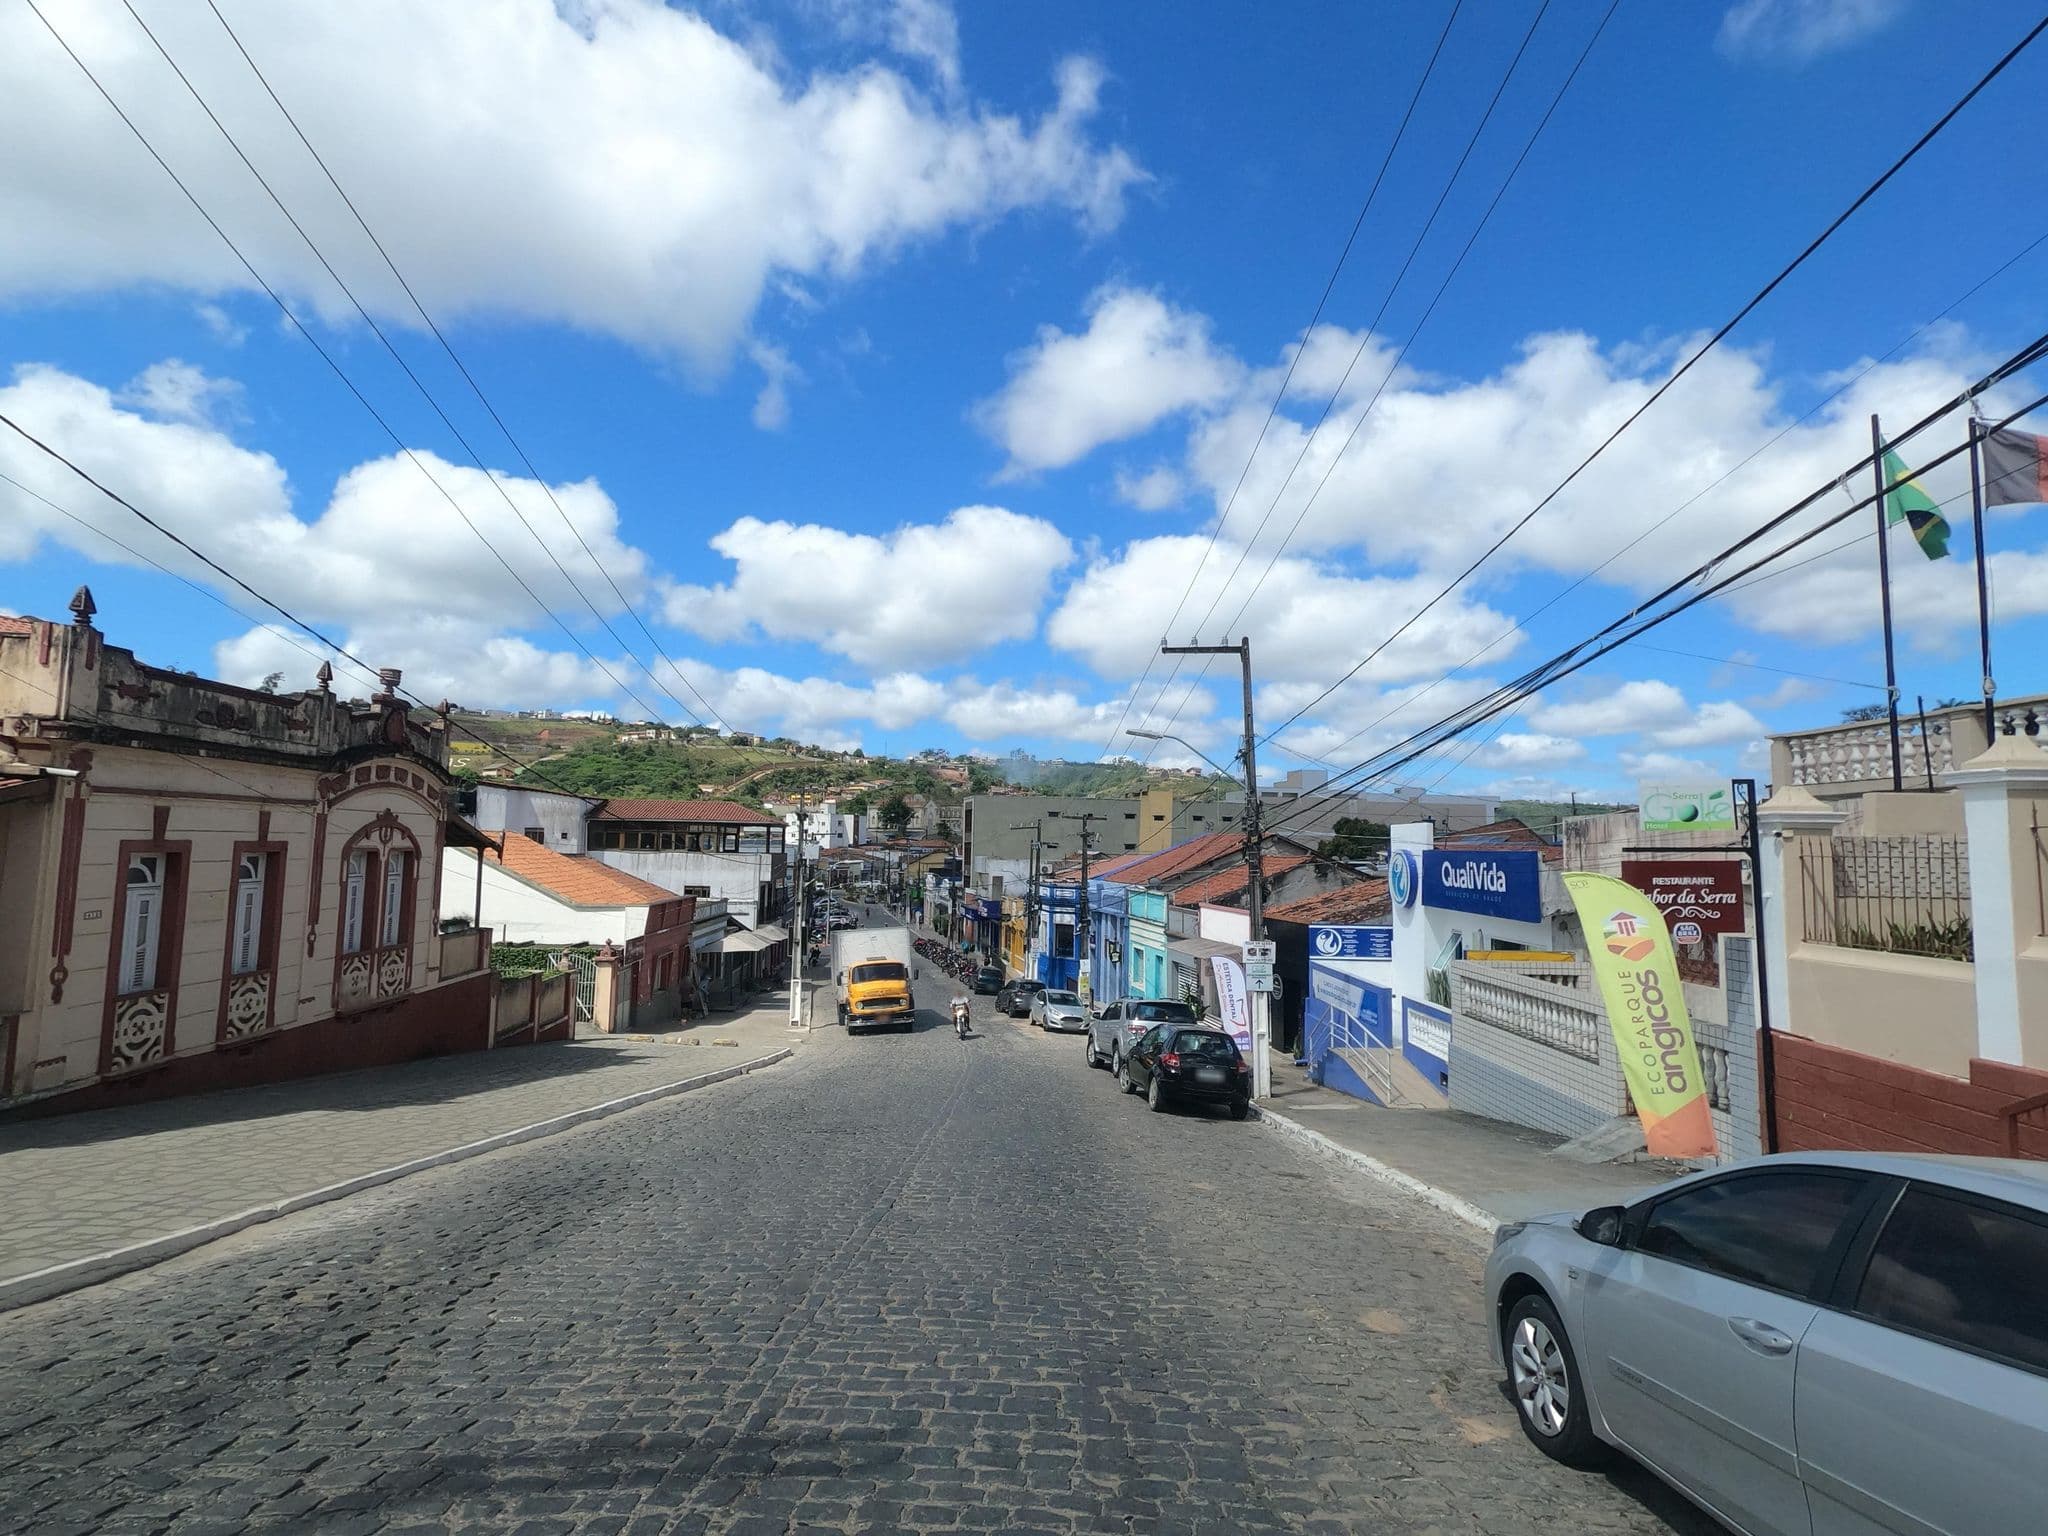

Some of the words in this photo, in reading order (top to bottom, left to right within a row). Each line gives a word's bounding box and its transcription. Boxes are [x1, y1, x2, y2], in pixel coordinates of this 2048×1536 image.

[1442, 861, 1506, 892] QualiVida
[1652, 877, 1715, 885] RESTAURANTE
[1677, 888, 1695, 904] da
[1698, 888, 1737, 904] Serra
[1618, 970, 1665, 1095] ECOPARQUE
[1635, 969, 1688, 1094] angicos
